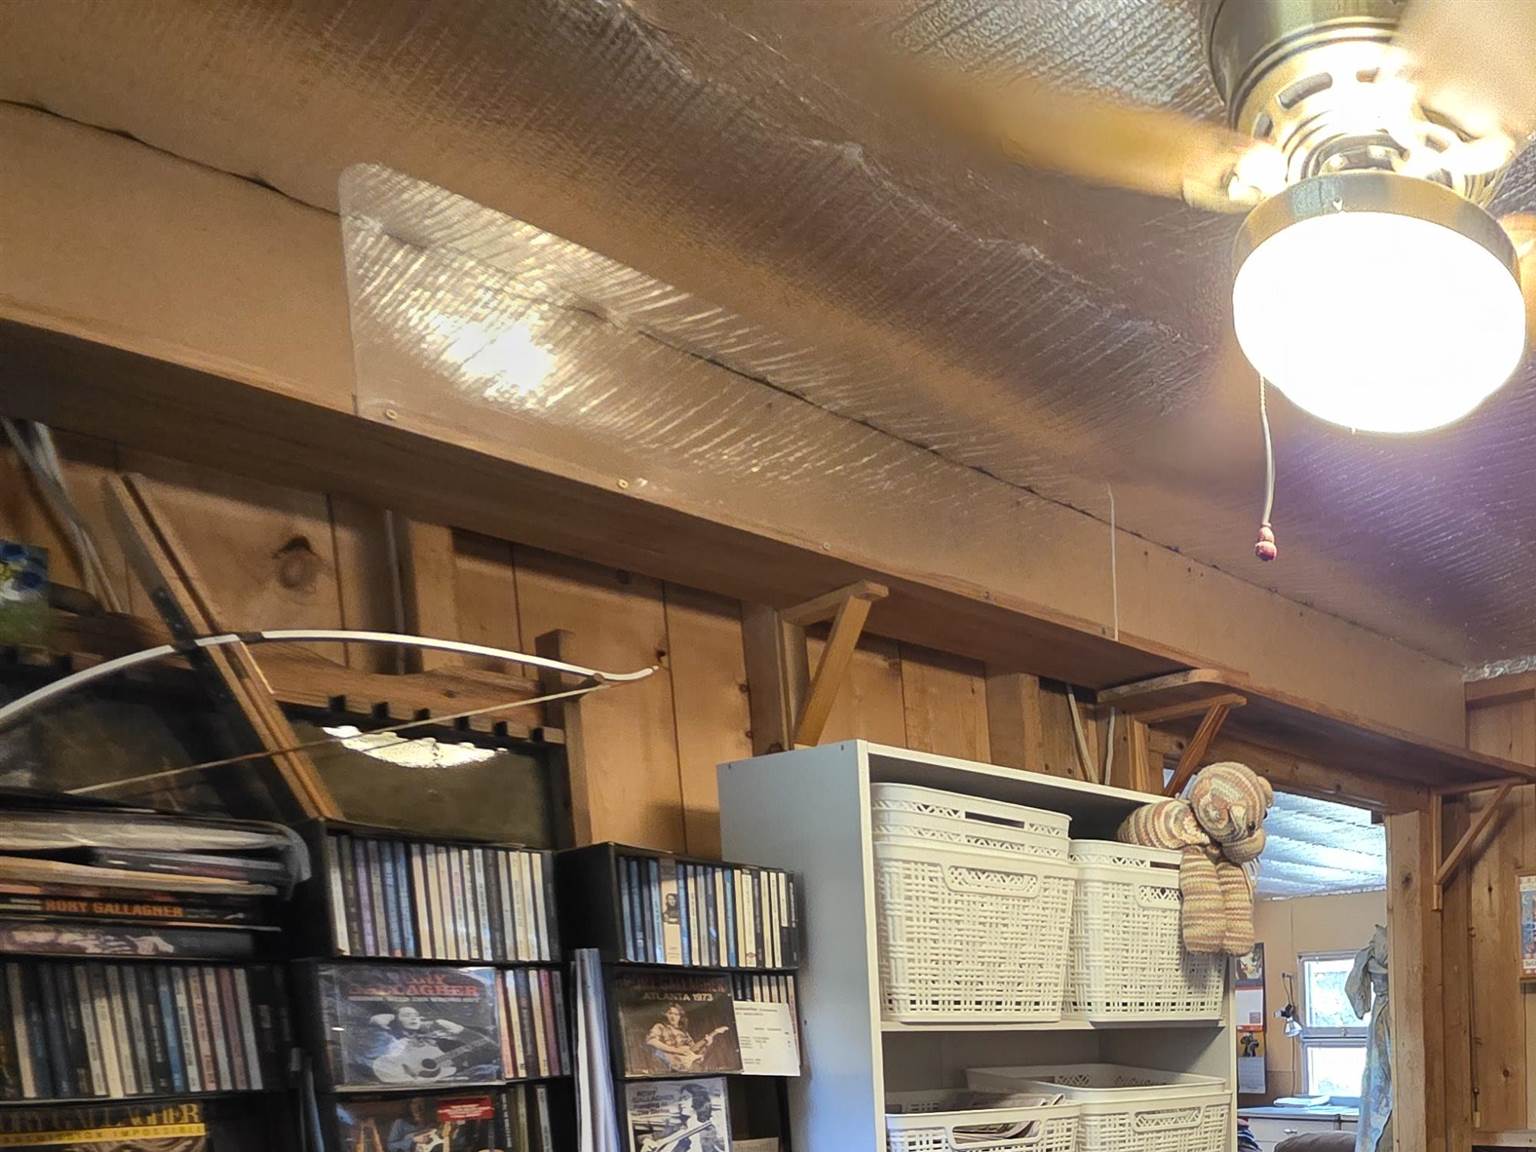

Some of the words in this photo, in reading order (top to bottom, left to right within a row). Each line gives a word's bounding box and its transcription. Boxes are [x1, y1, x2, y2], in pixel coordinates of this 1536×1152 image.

[93, 902, 183, 917] GALLAGHER
[643, 993, 691, 1002] ATLANTA
[692, 993, 715, 1002] 1973
